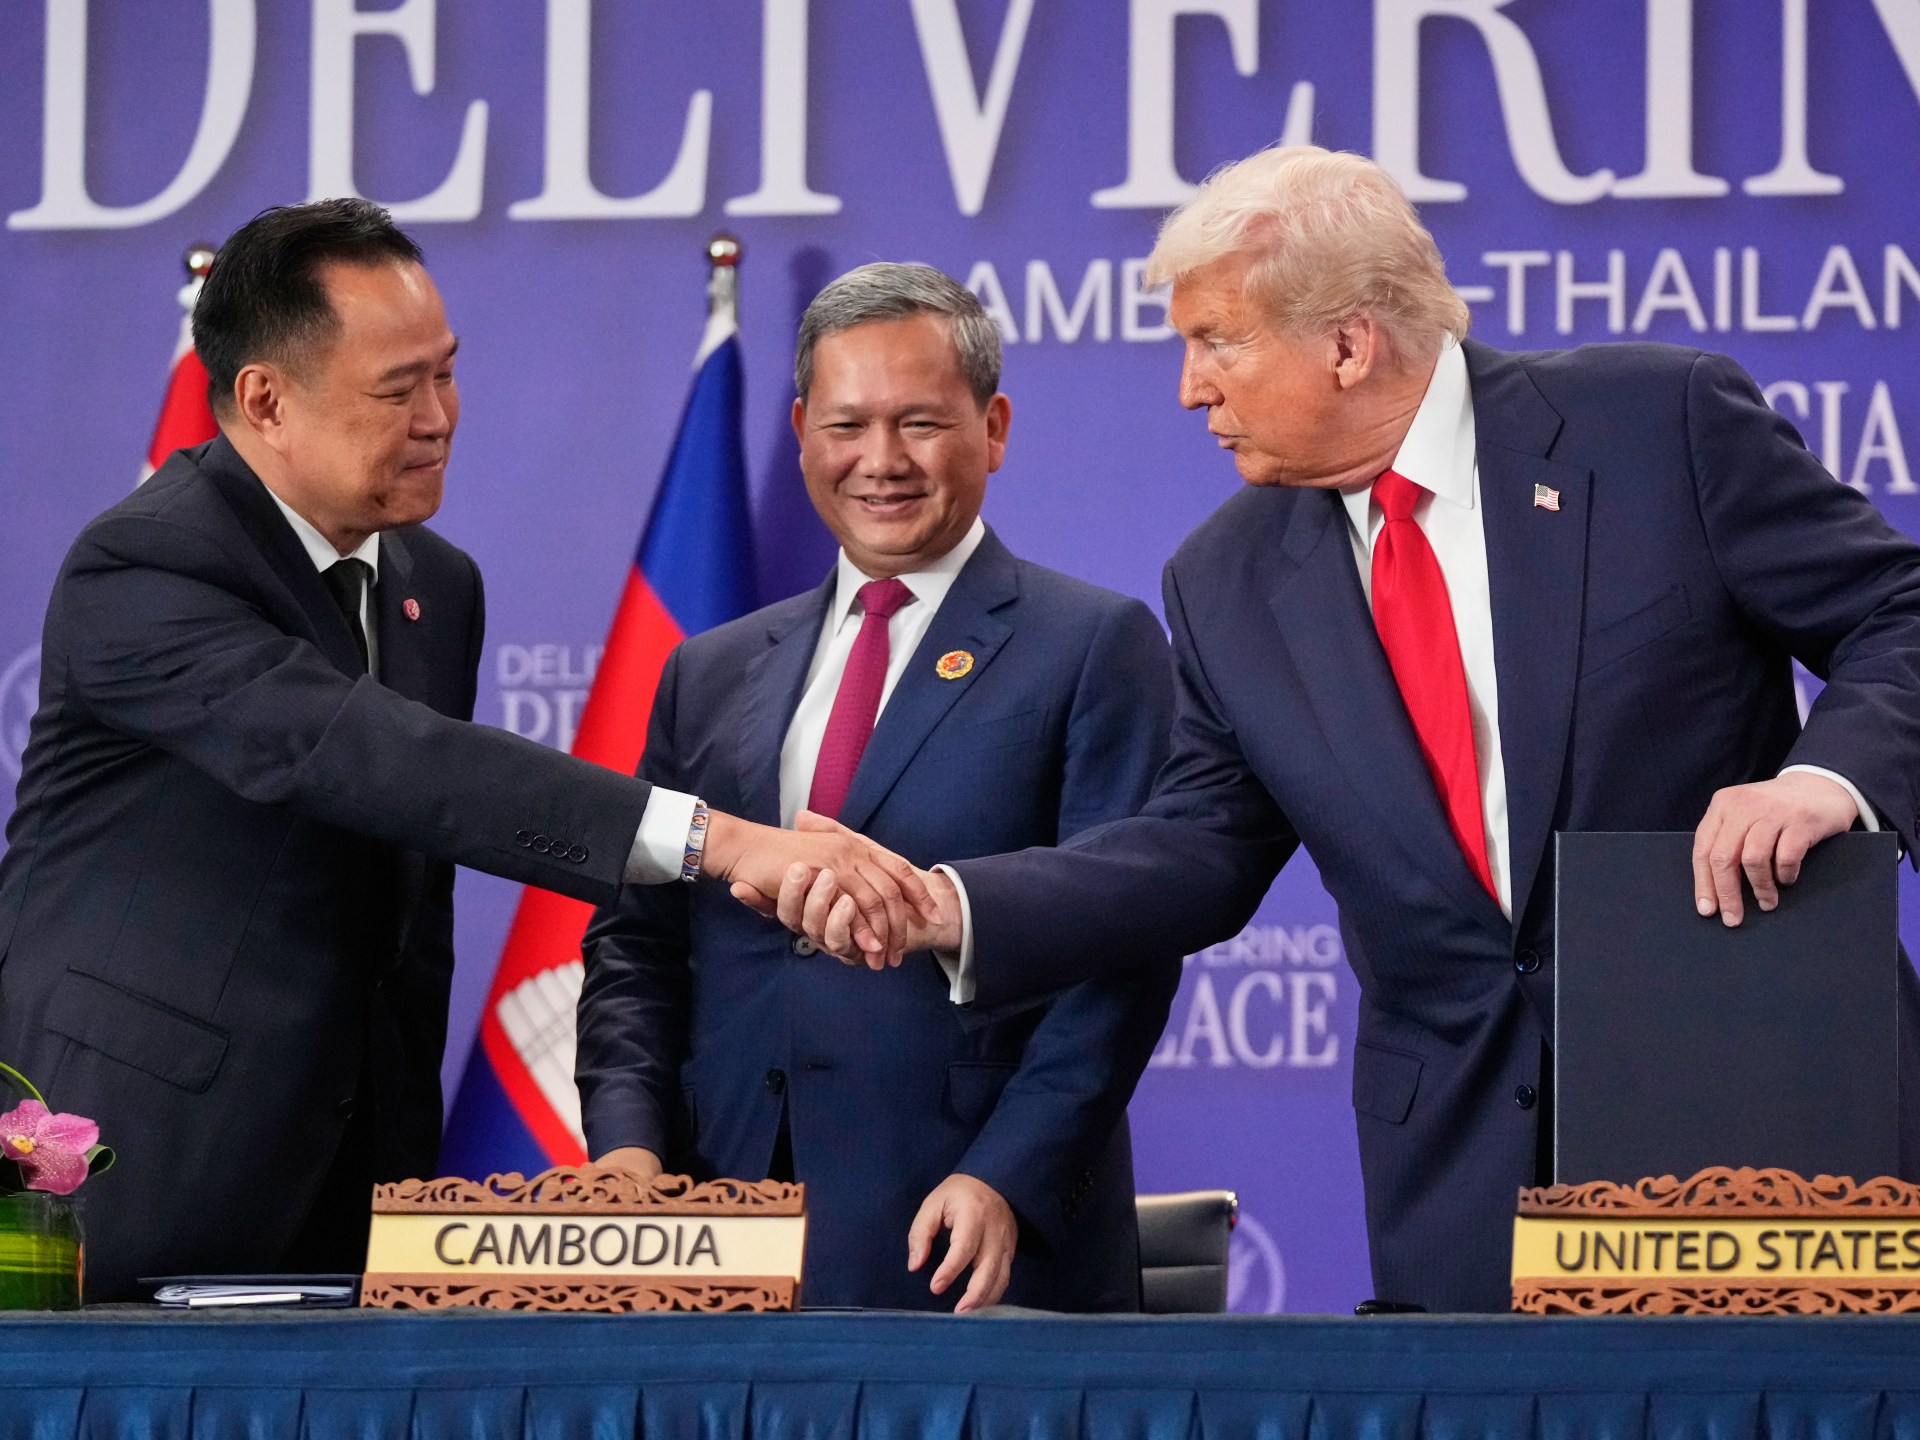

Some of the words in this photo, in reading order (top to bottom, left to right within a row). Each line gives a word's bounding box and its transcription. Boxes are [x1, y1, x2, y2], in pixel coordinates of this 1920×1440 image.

[435, 1222, 720, 1266] CAMBODIA
[1556, 1231, 1741, 1271] UNITED
[1757, 1229, 1920, 1271] STATES
